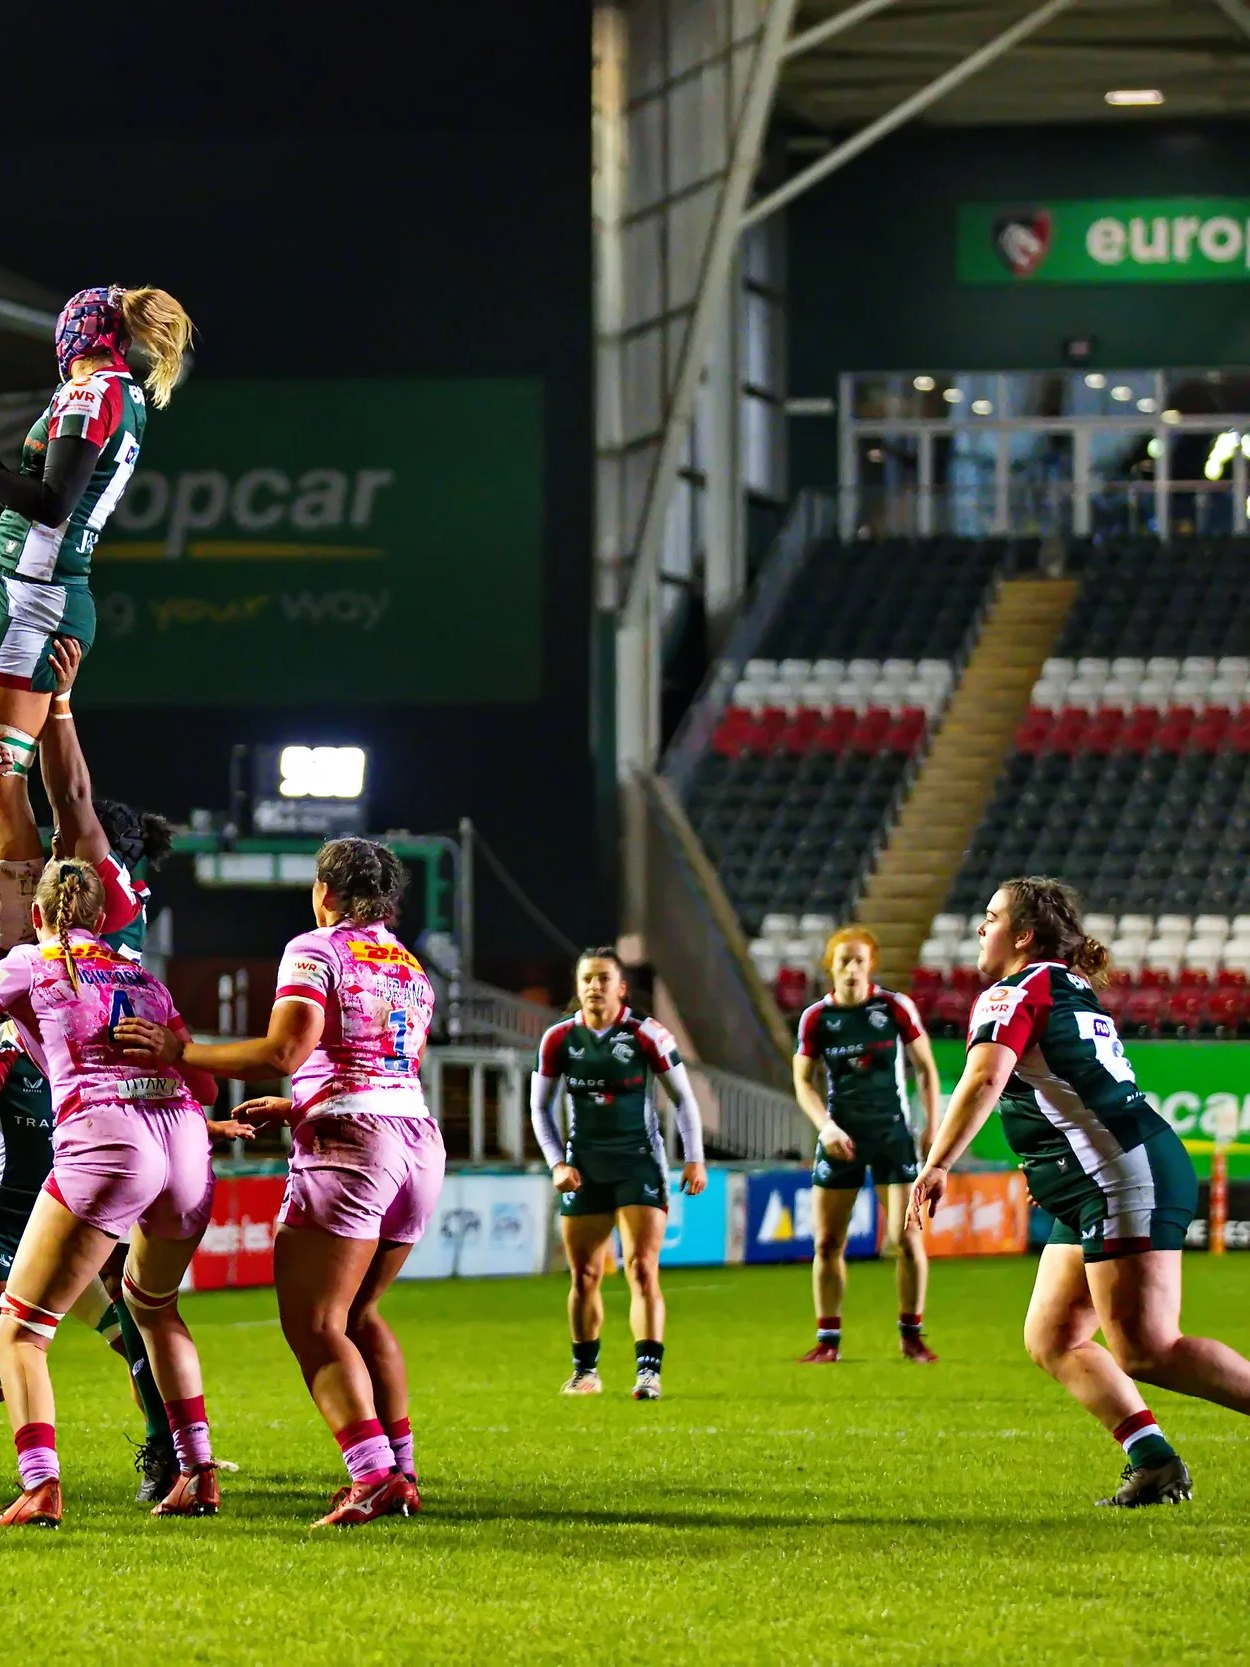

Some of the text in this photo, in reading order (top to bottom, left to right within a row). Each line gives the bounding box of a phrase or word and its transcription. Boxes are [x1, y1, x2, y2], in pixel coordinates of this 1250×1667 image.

[1086, 215, 1250, 270] euro
[116, 467, 394, 560] opcar
[384, 1009, 410, 1073] 1
